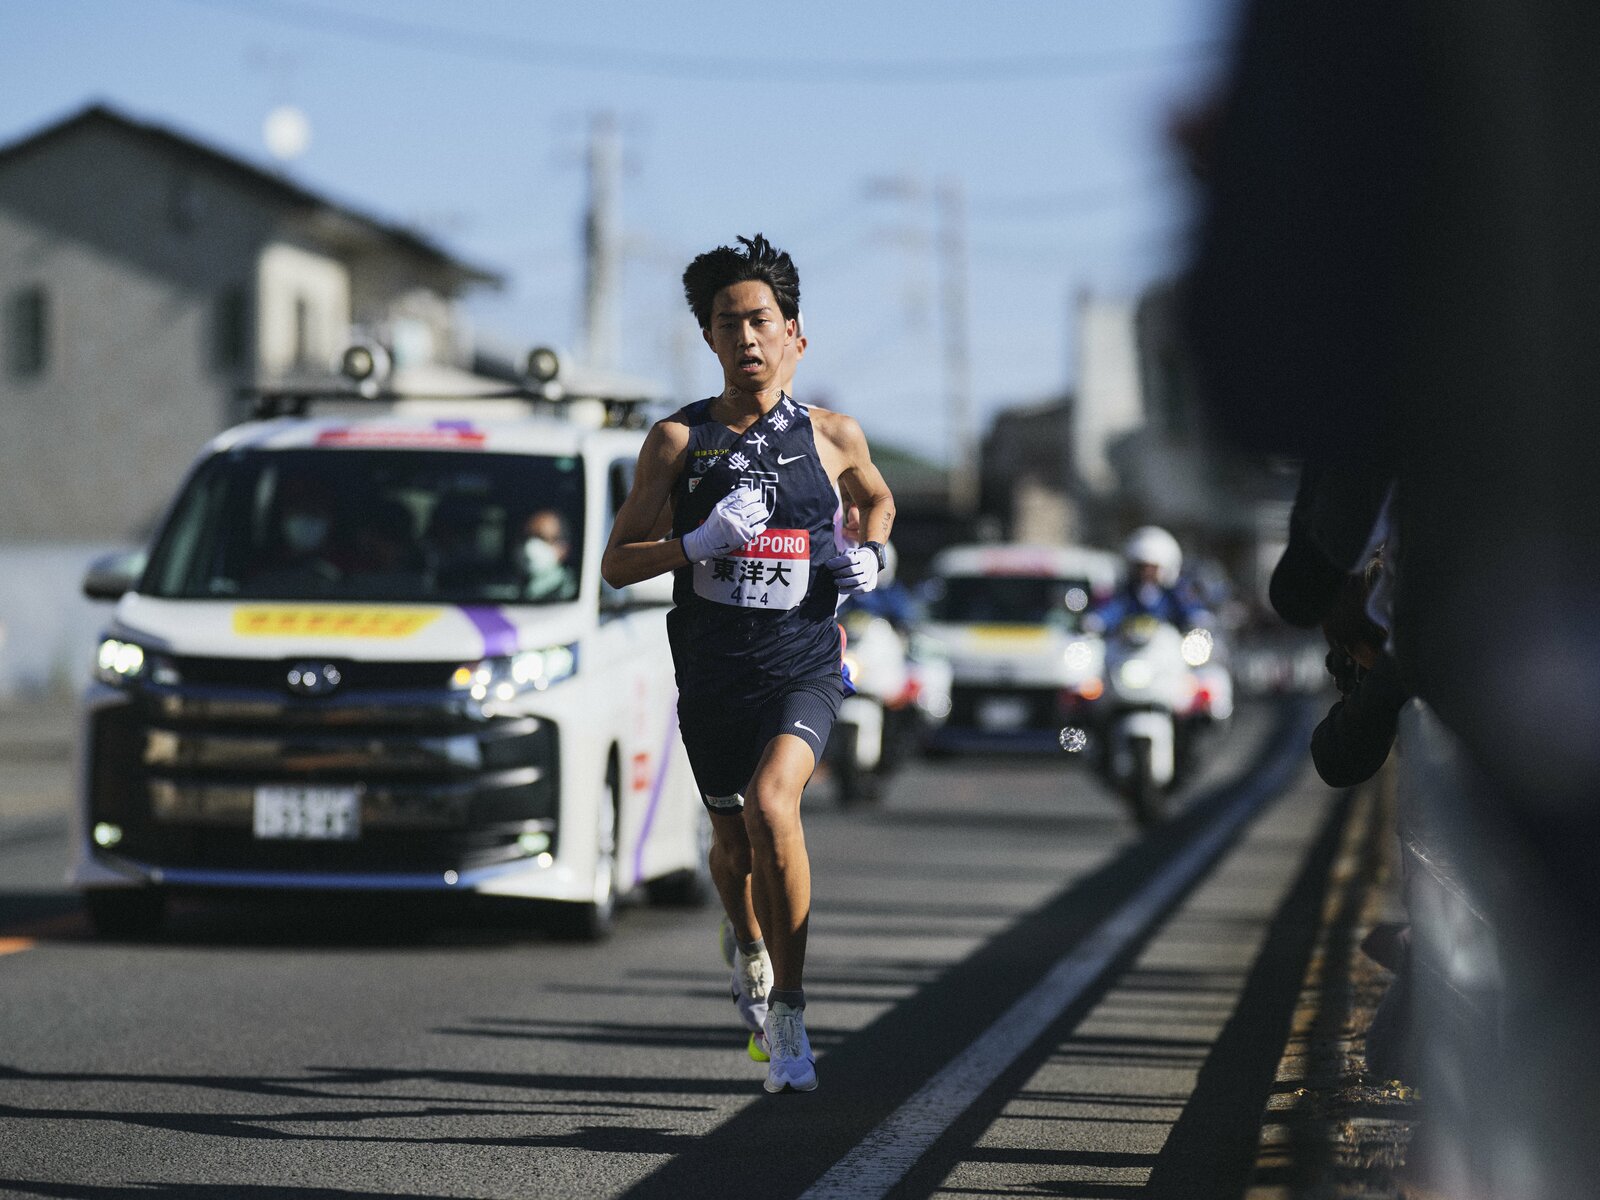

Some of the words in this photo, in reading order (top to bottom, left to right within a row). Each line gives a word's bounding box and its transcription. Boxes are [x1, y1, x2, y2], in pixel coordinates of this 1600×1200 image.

[741, 536, 806, 554] PPORO
[712, 558, 791, 587] 東洋大
[731, 586, 768, 605] 4-4
